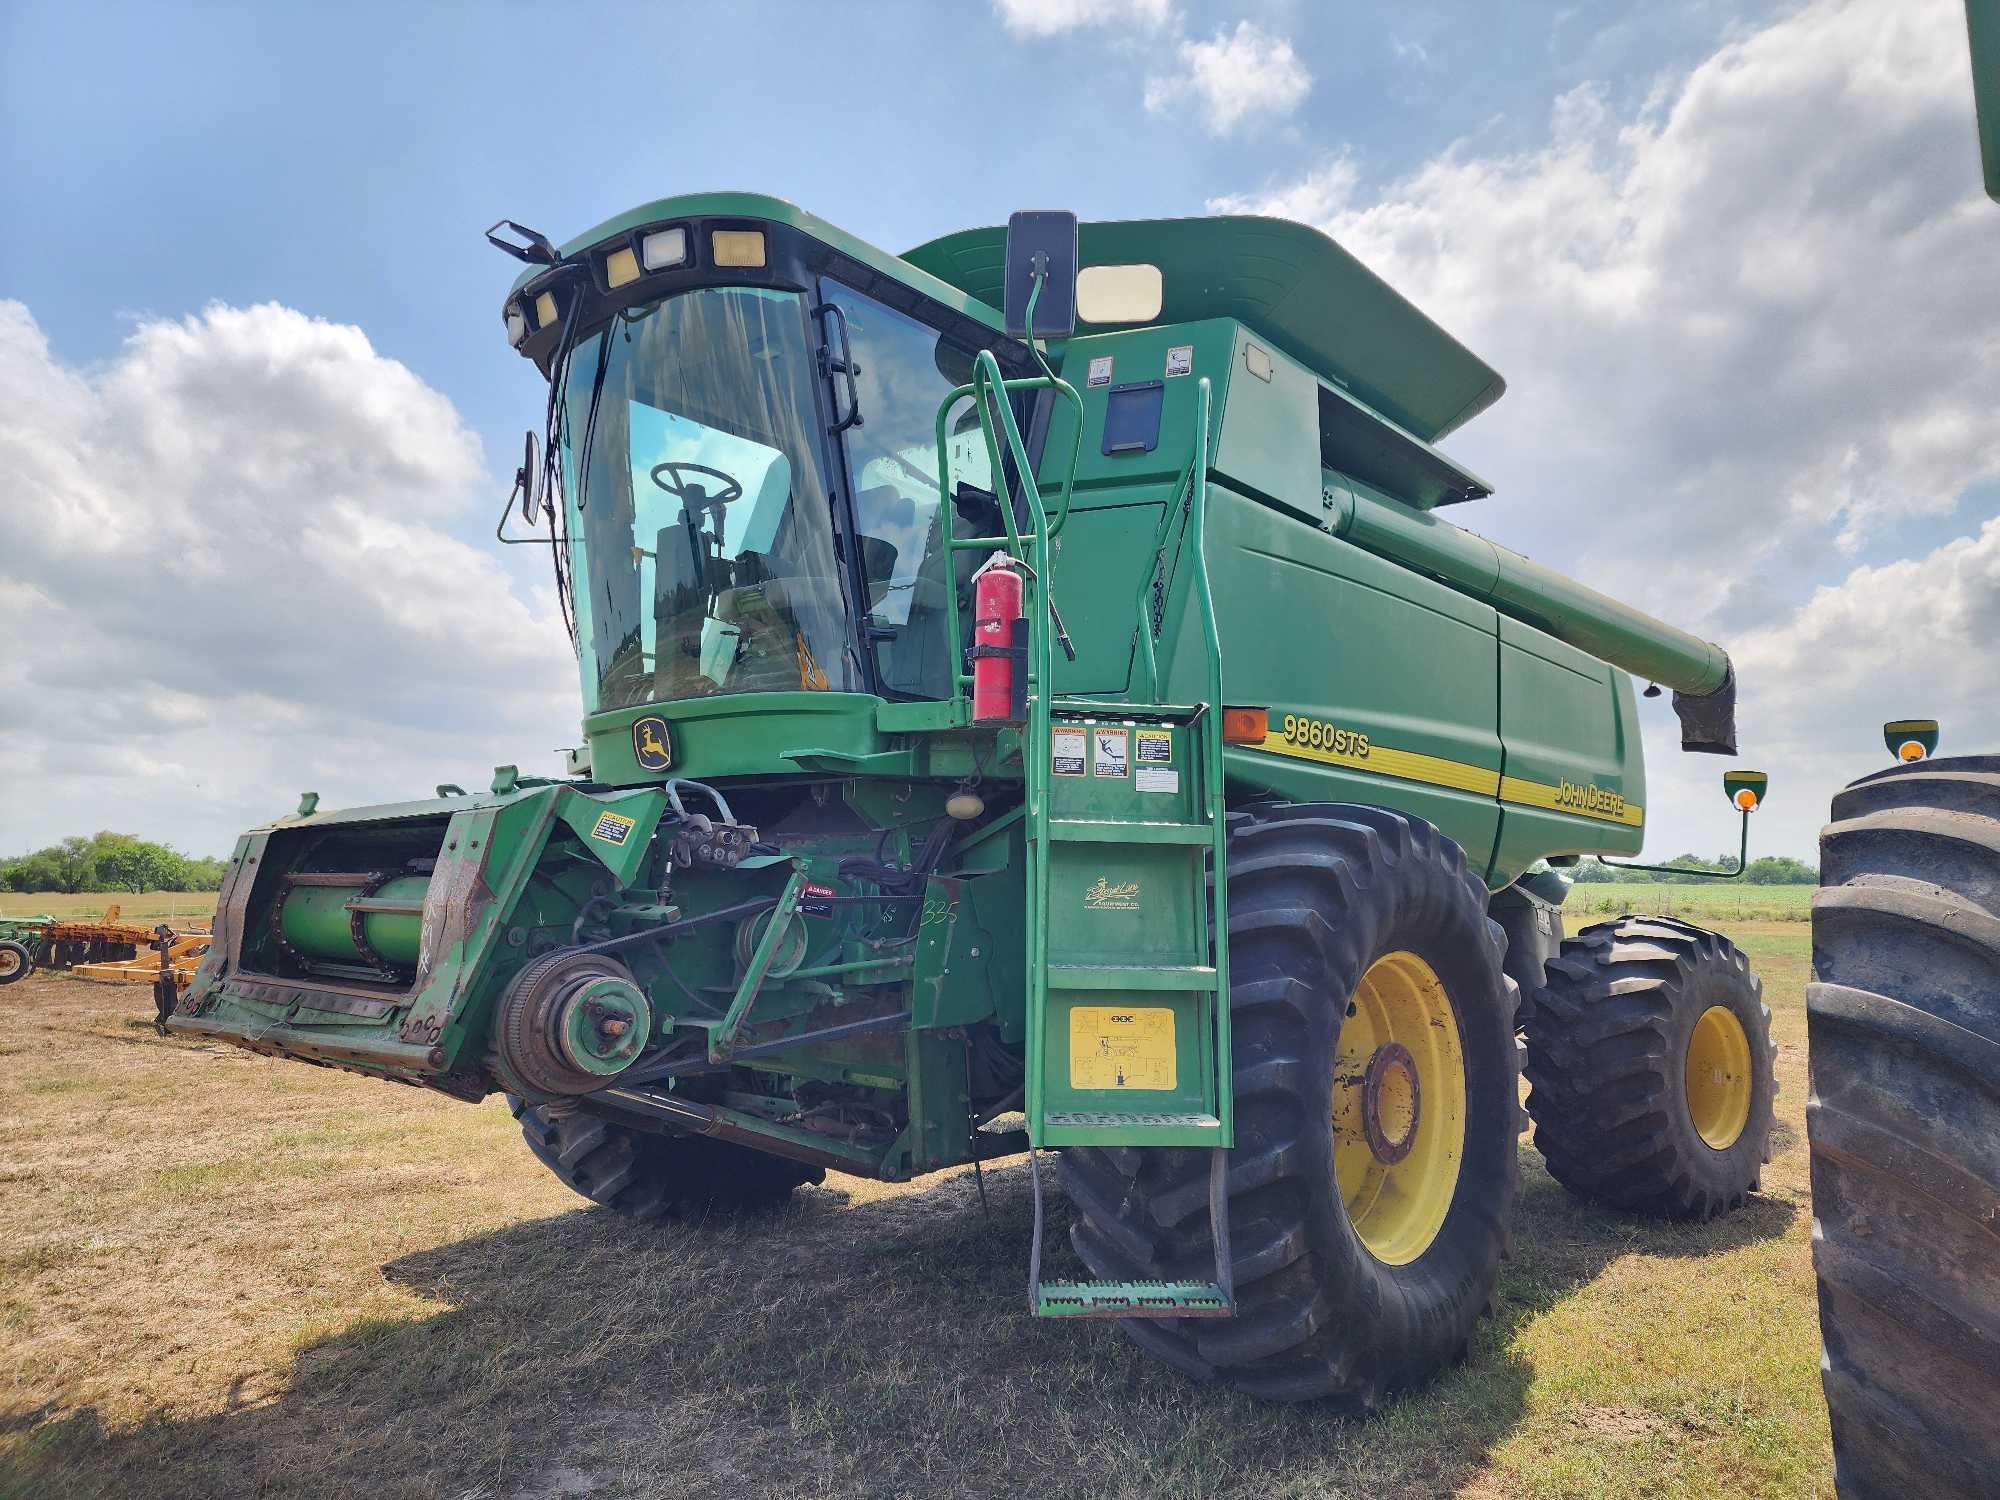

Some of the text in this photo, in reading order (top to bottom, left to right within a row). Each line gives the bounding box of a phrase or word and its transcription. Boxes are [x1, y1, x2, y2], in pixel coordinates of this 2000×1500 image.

[1283, 713, 1370, 760] 9860STS
[1555, 776, 1625, 815] JOHN DEERE
